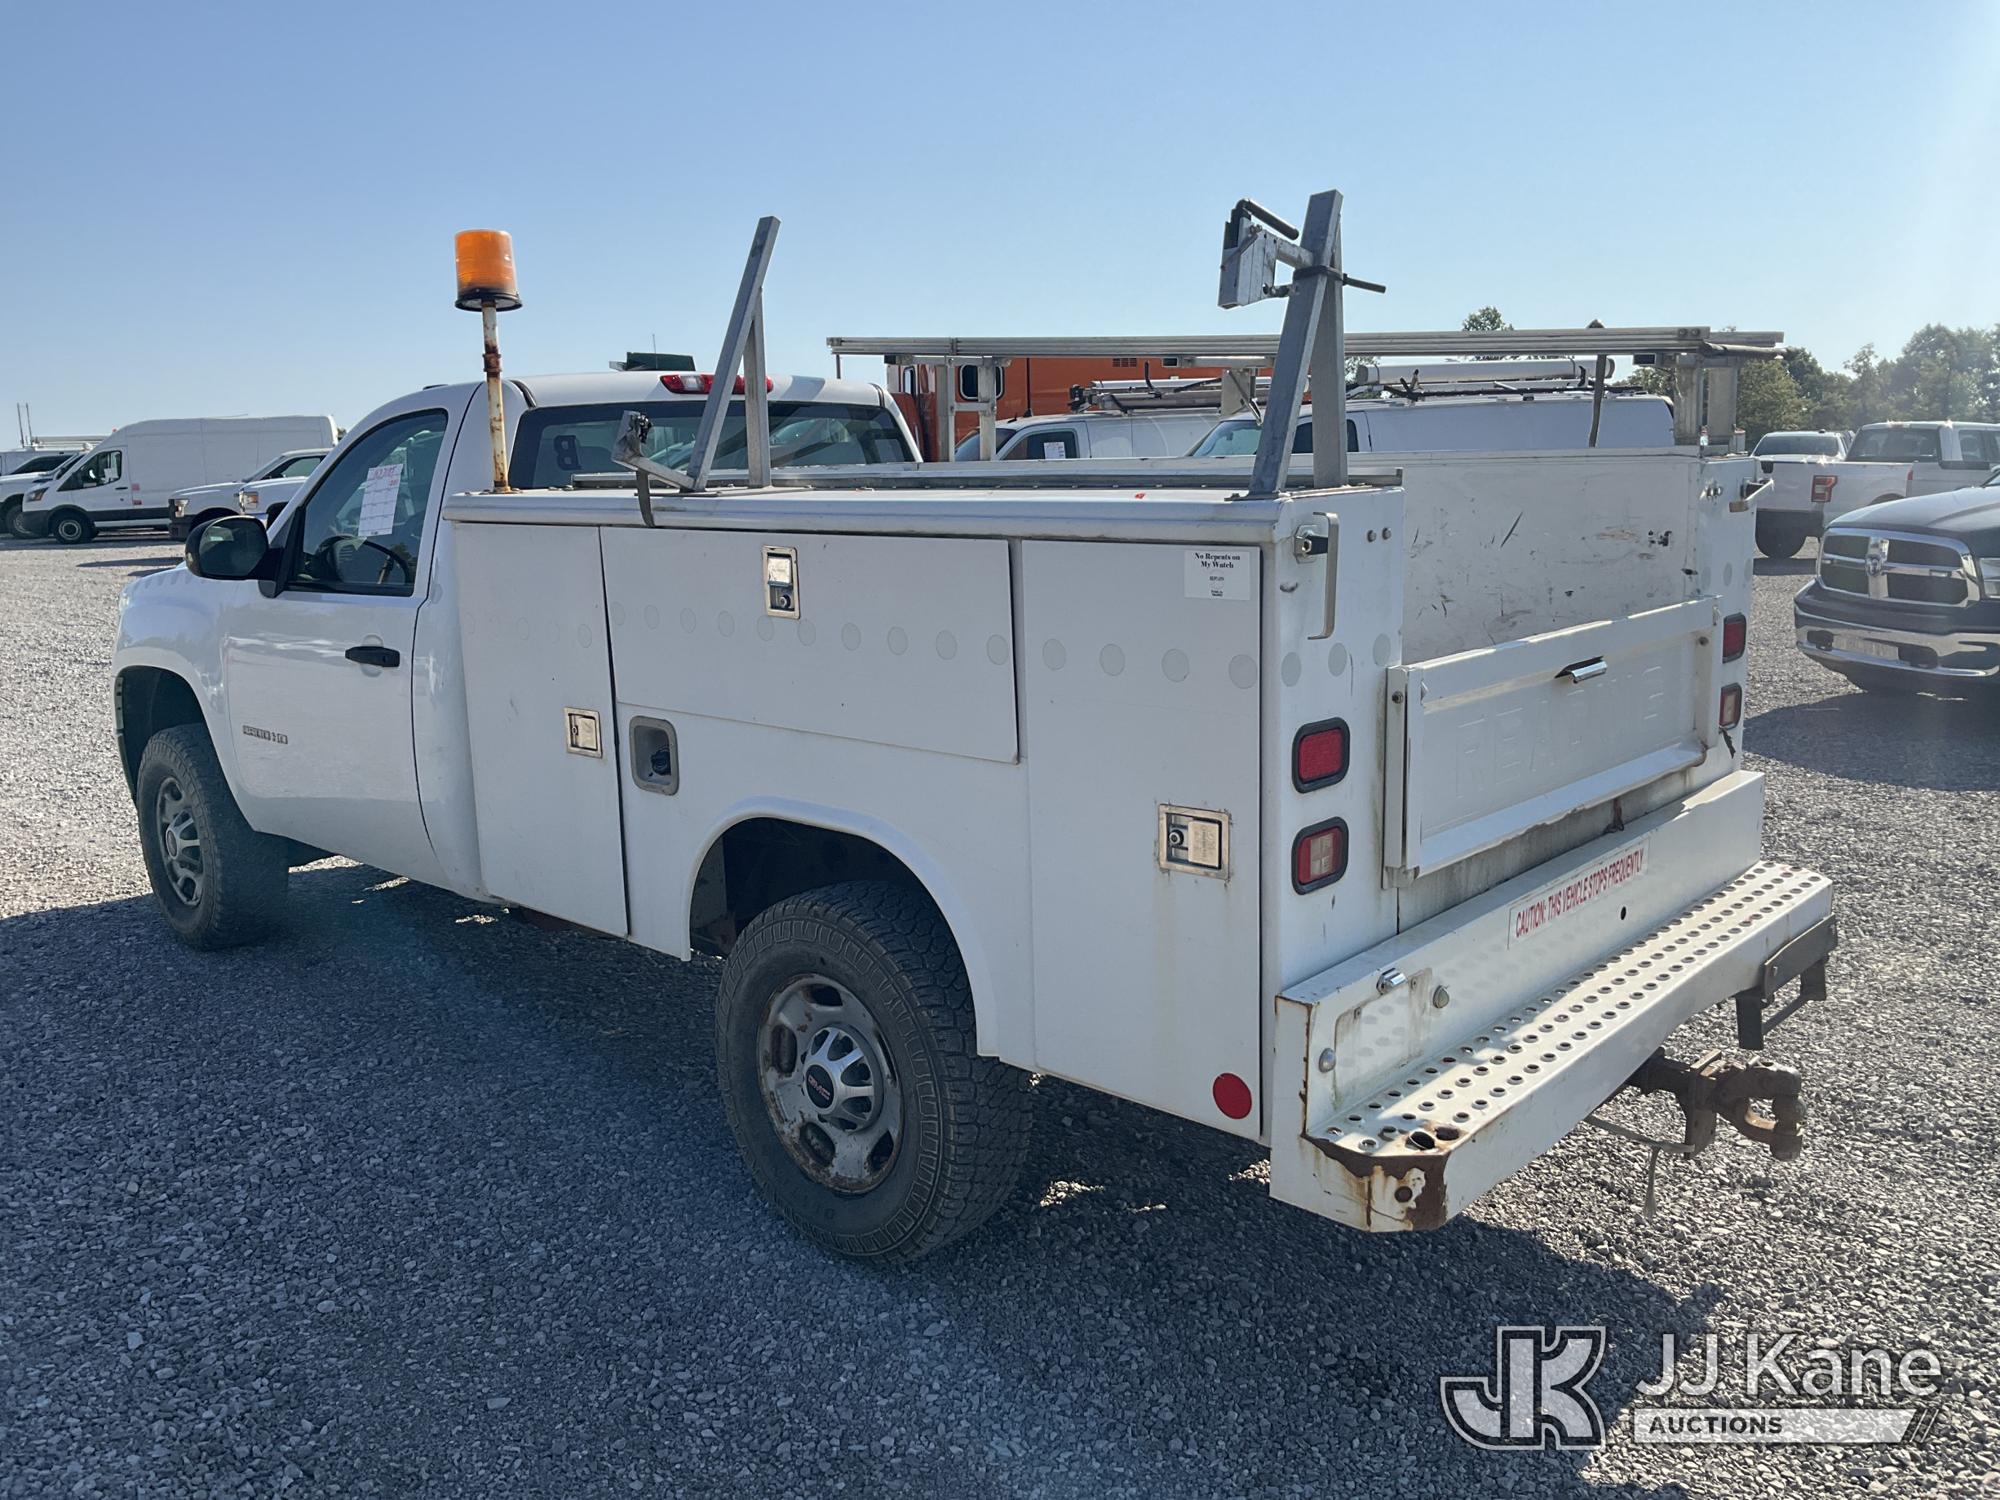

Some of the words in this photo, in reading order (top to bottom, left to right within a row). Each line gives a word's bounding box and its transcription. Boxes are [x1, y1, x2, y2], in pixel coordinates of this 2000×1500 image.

[1194, 552, 1204, 560] No
[1205, 553, 1231, 561] Repeats
[1201, 560, 1211, 569] My
[1516, 901, 1546, 937] CAUTION:
[1547, 891, 1561, 921] THIS
[1562, 877, 1588, 913] VEHICLE
[1588, 866, 1608, 898] STOPS
[1607, 848, 1644, 887] FREQUENTLY
[809, 1075, 830, 1100] GMC
